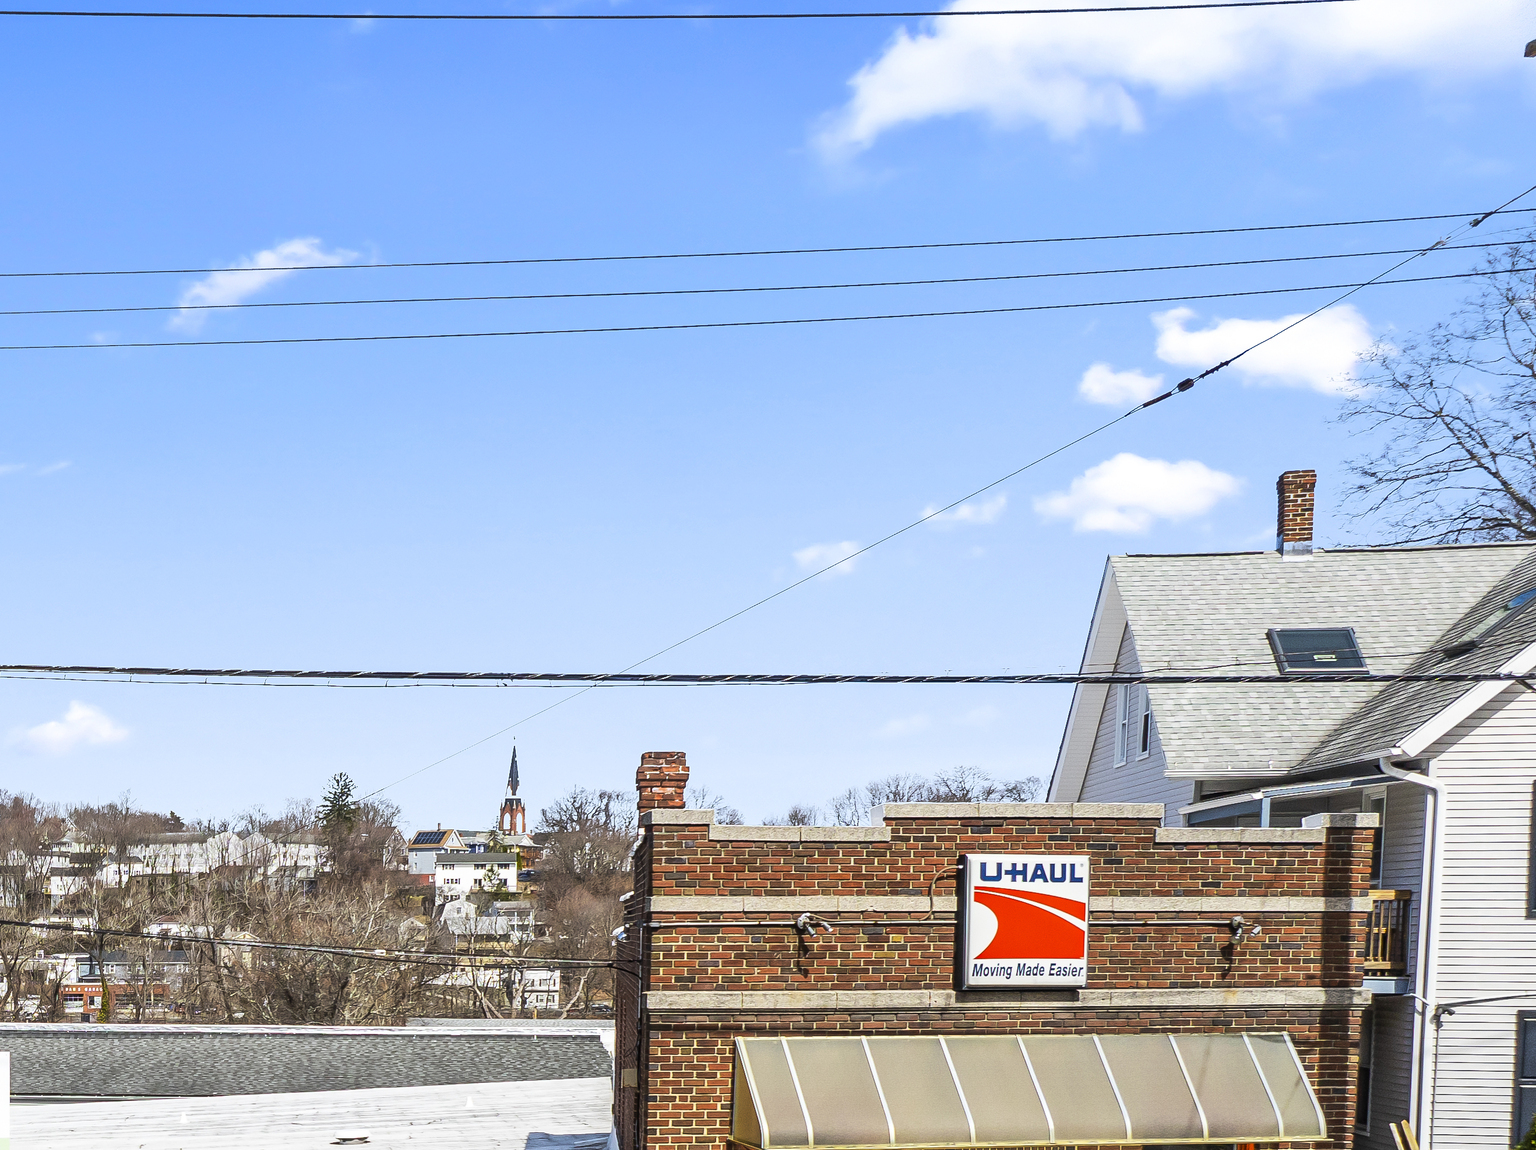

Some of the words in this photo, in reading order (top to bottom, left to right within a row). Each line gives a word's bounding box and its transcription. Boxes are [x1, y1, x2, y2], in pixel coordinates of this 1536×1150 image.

[979, 862, 1084, 883] U-HAUL
[971, 963, 1013, 979] Moving
[1015, 963, 1045, 977] Made
[1048, 963, 1084, 977] Easier
